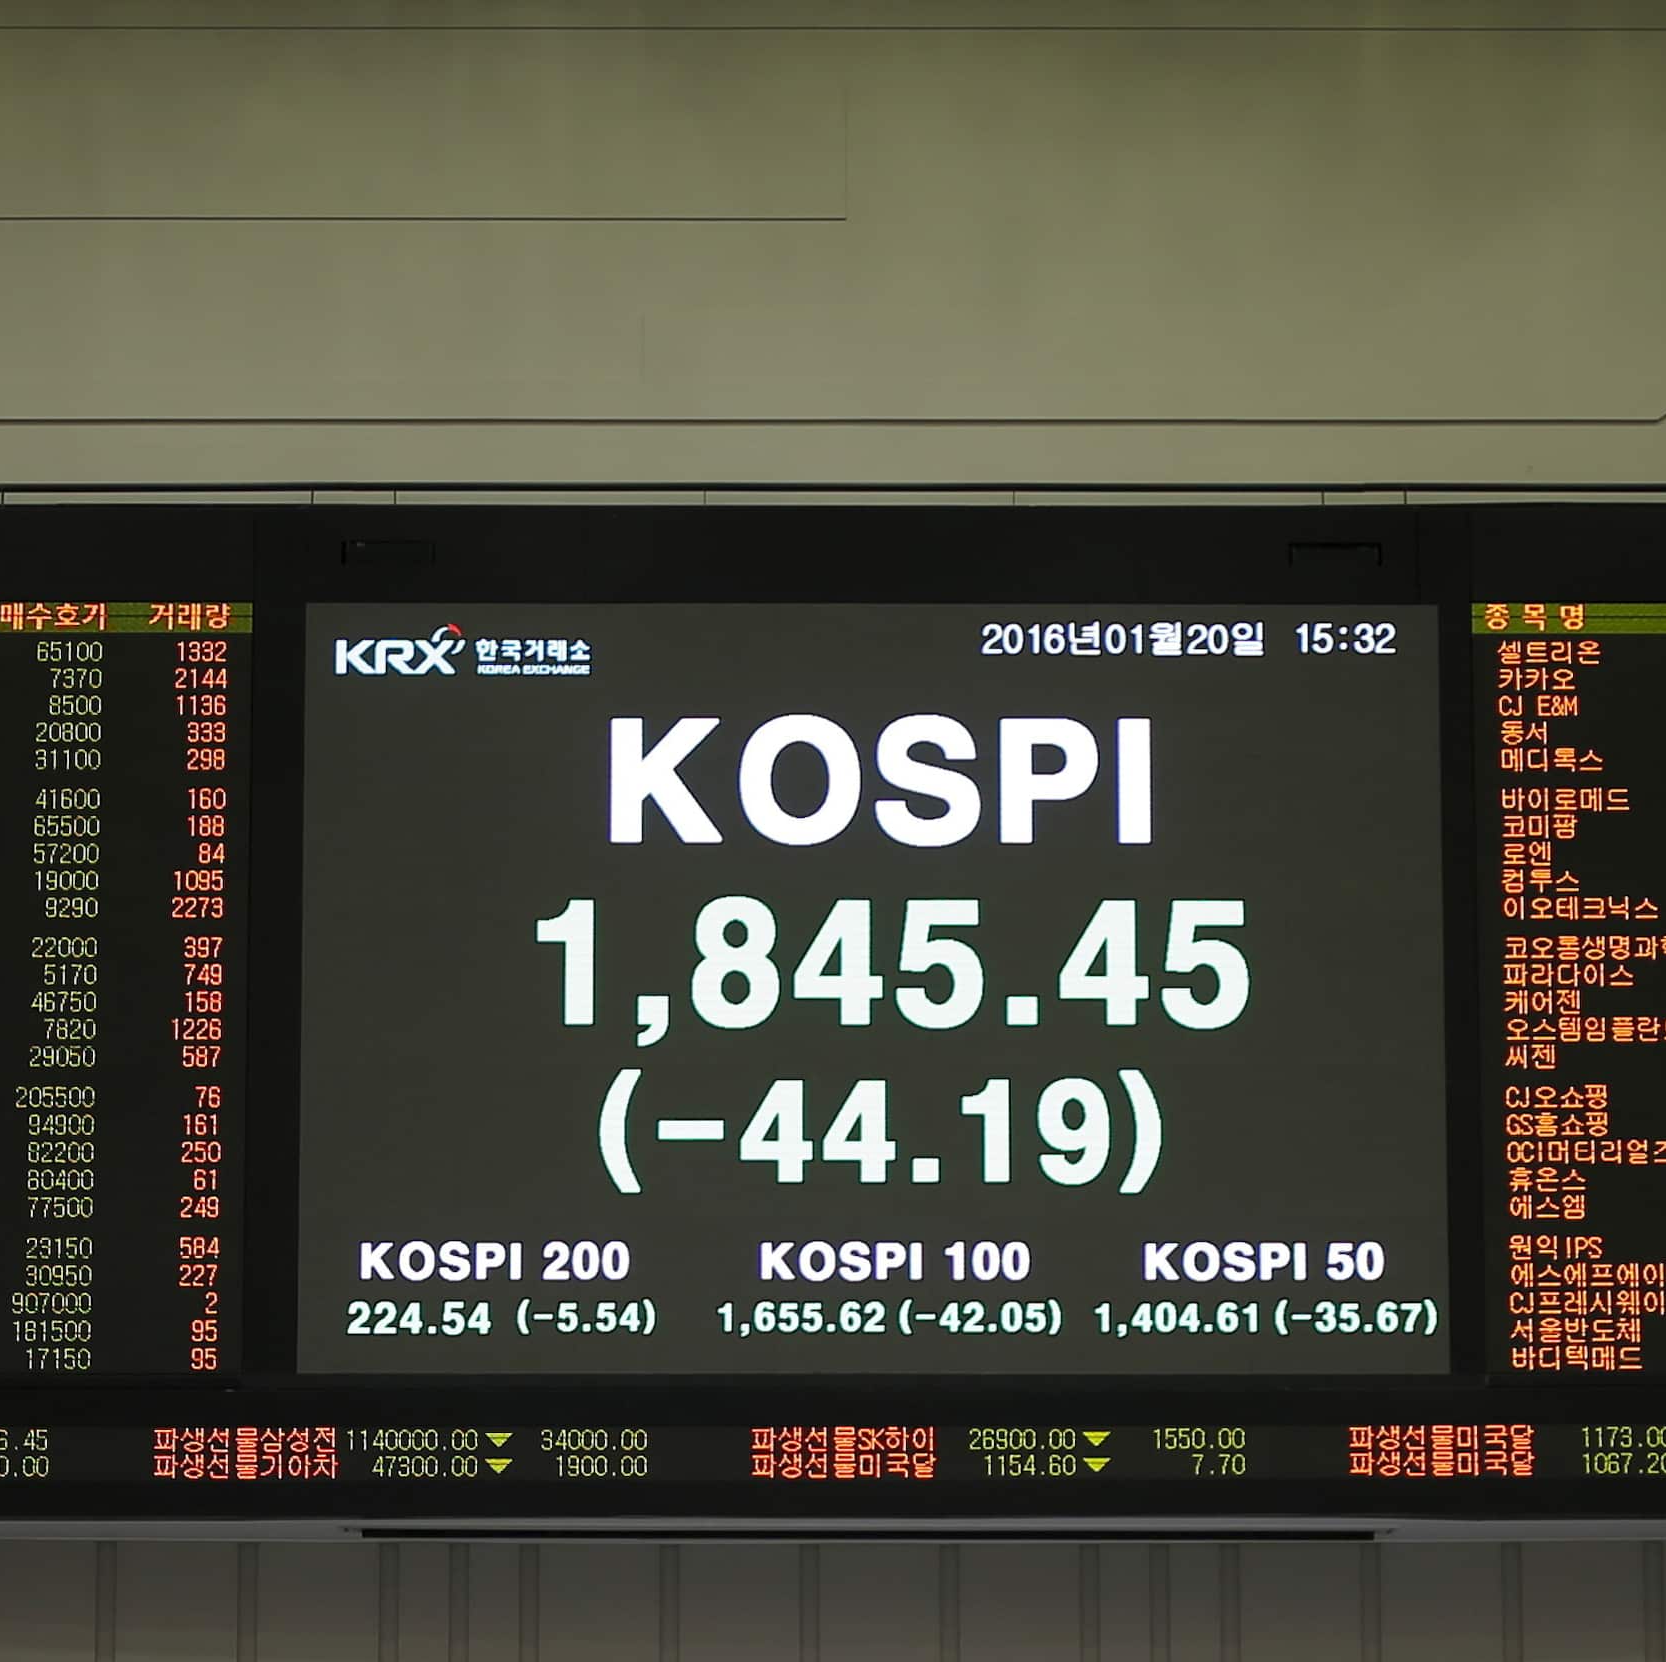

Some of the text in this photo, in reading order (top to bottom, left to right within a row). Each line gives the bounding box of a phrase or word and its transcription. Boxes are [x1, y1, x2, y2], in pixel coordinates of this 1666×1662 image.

[36, 640, 103, 662] 65100
[176, 640, 228, 663] 1332
[335, 639, 456, 675] KRX
[476, 638, 592, 662] 한국거래소
[981, 621, 1396, 657] 2016년01월20일 15:32
[1496, 639, 1601, 665] 셀트리온
[477, 664, 591, 675] KOREA EXCHANGE
[610, 714, 1153, 848] KOSPI
[1501, 813, 1579, 840] 코미팜
[33, 842, 100, 865] 57200
[198, 842, 226, 865] 84
[536, 895, 1251, 1048] 1,845.45
[29, 1045, 96, 1068] 29050
[182, 1045, 222, 1068] 587
[1504, 1043, 1556, 1070] 씨젠
[598, 1068, 1163, 1195] (-44.19)
[359, 1240, 631, 1282] KOSPI 200
[759, 1240, 1032, 1282] KOSPI 100
[1143, 1240, 1386, 1282] KOSPI 50
[347, 1298, 657, 1337] 224.54 (-5.54)
[717, 1298, 1063, 1340] 1,655.62 (-42.05)
[1094, 1298, 1438, 1340] 1,404.61 (-35.67)
[1510, 1318, 1641, 1344] 서울반도체
[25, 1347, 91, 1370] 17150
[190, 1347, 217, 1371] 95
